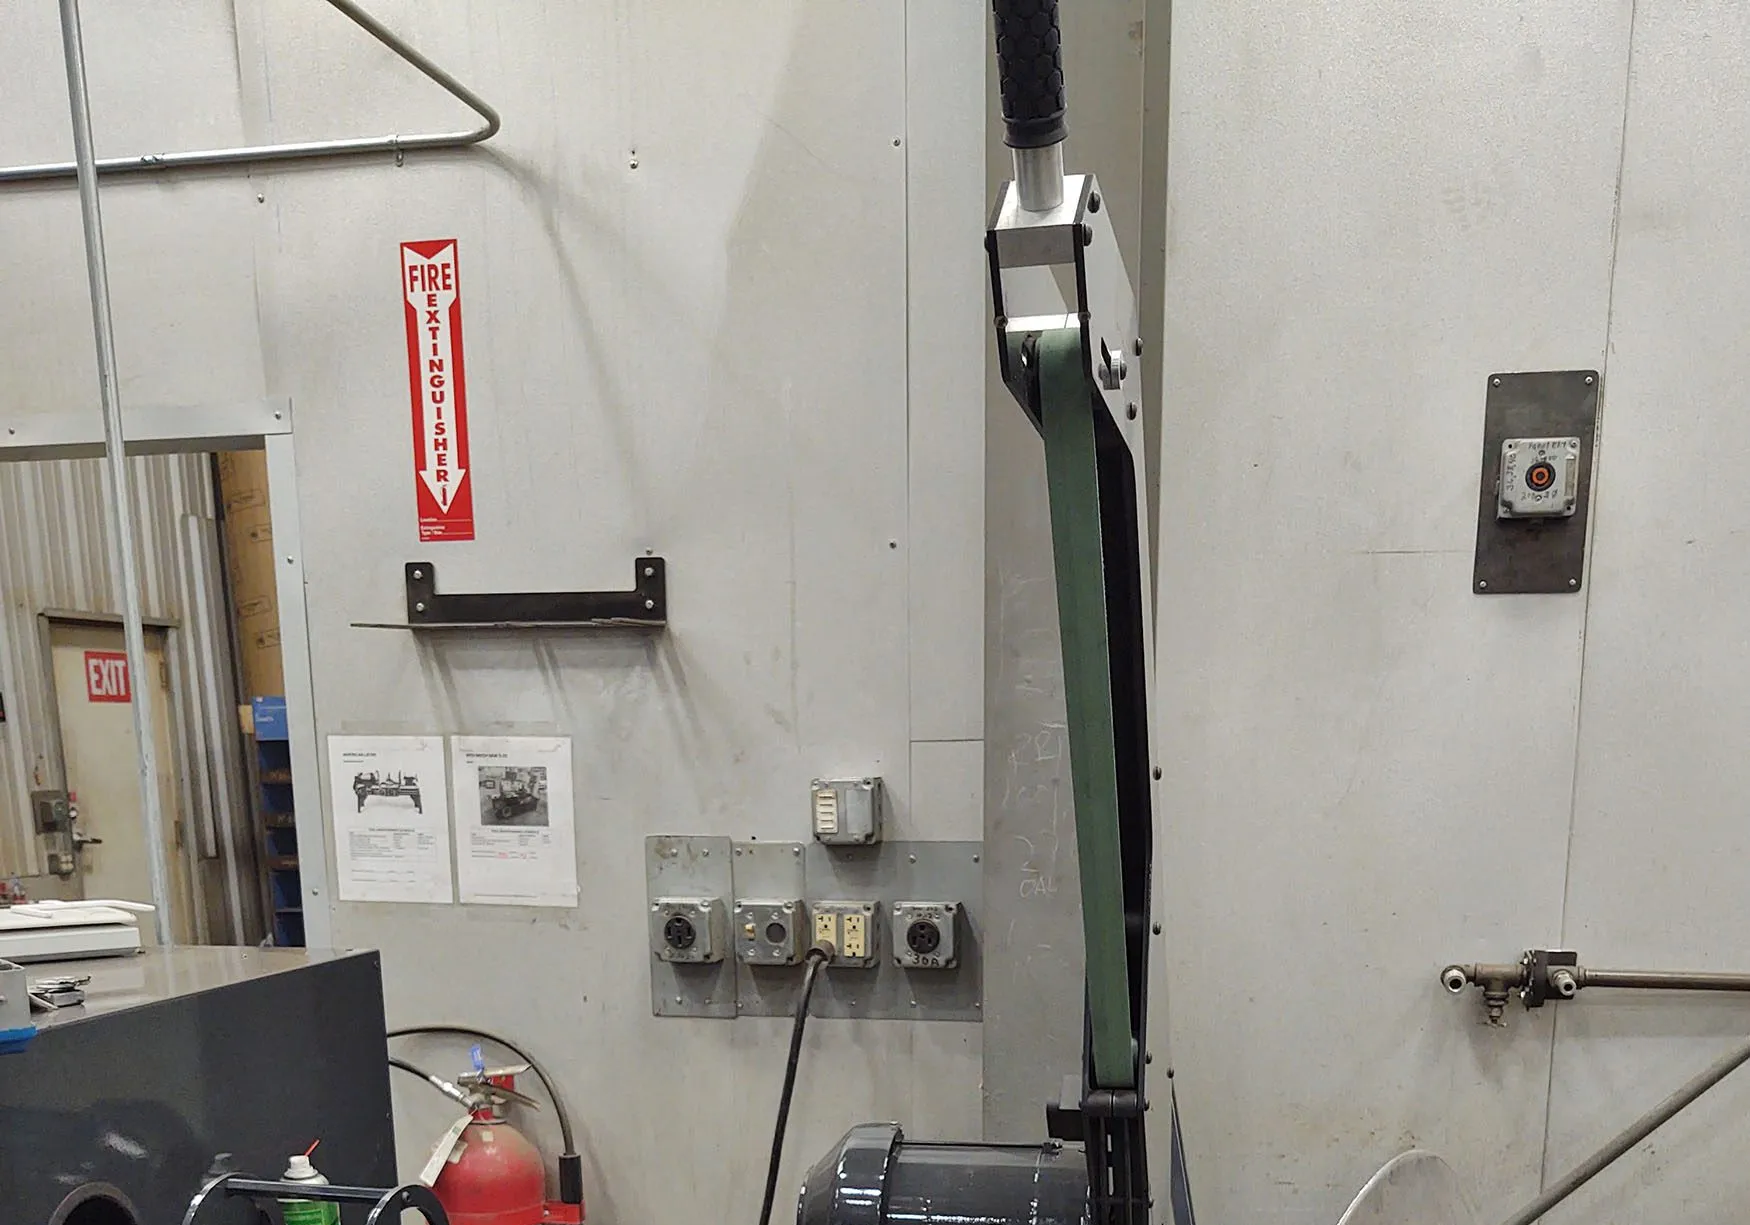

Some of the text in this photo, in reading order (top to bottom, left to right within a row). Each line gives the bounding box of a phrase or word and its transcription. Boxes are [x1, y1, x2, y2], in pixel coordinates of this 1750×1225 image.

[408, 263, 453, 292] FIRE
[425, 294, 450, 483] EXTINGUISHER
[88, 658, 126, 696] EXIT
[911, 952, 940, 968] 30A
